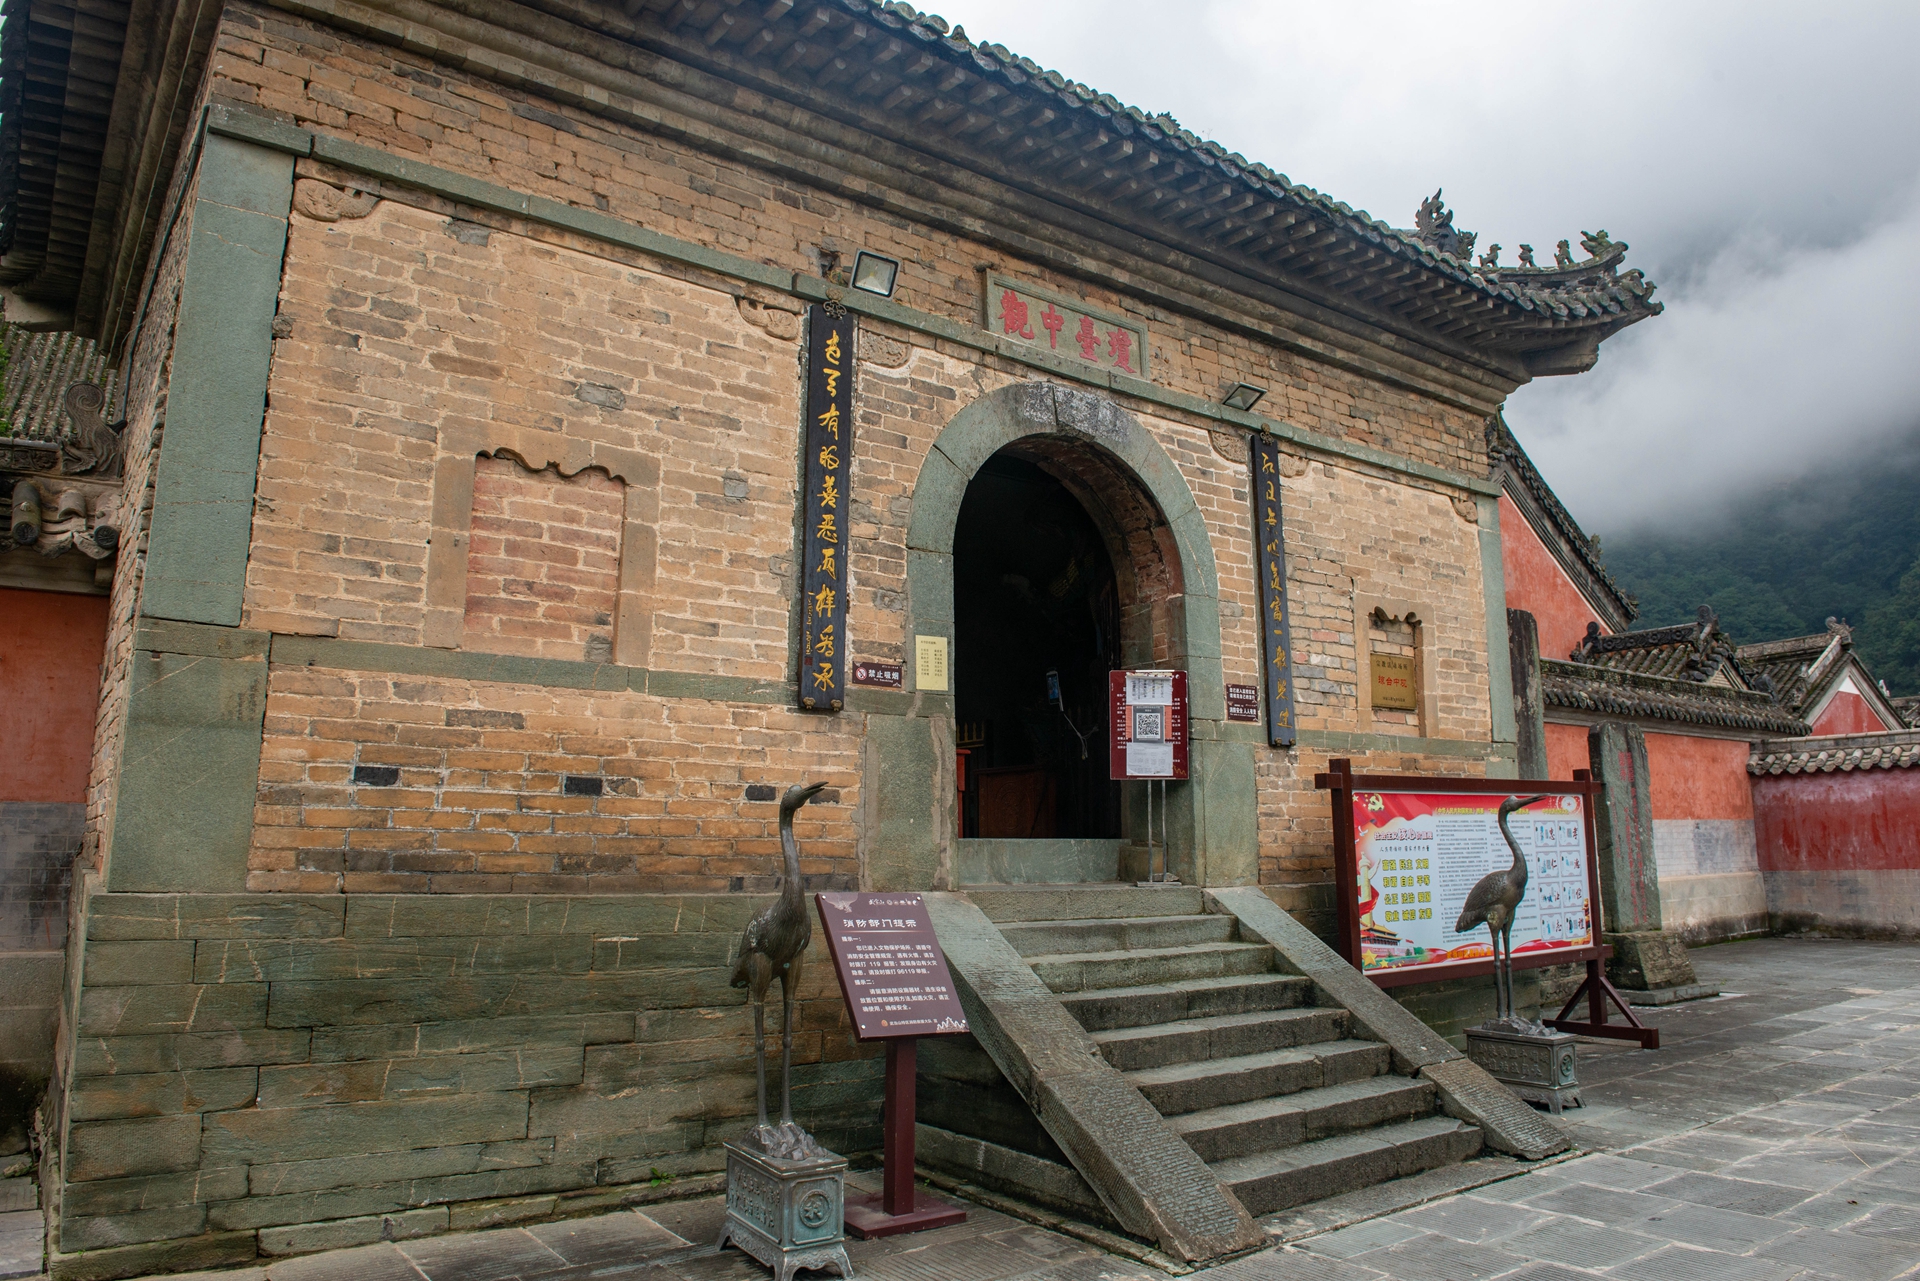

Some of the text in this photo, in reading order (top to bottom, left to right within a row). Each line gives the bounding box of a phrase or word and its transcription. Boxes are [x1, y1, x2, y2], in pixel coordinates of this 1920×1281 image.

[868, 669, 900, 681] 禁止吸烟
[1373, 827, 1434, 841] 社会主义核心价值观
[1382, 858, 1429, 871] 富强 民主 文明
[1383, 875, 1431, 888] 和谐 自由 平等
[1384, 891, 1432, 905] 公正 法治 爱国
[1385, 908, 1433, 922] 敬业 诚信 友善
[842, 918, 917, 928] 消防部门提示
